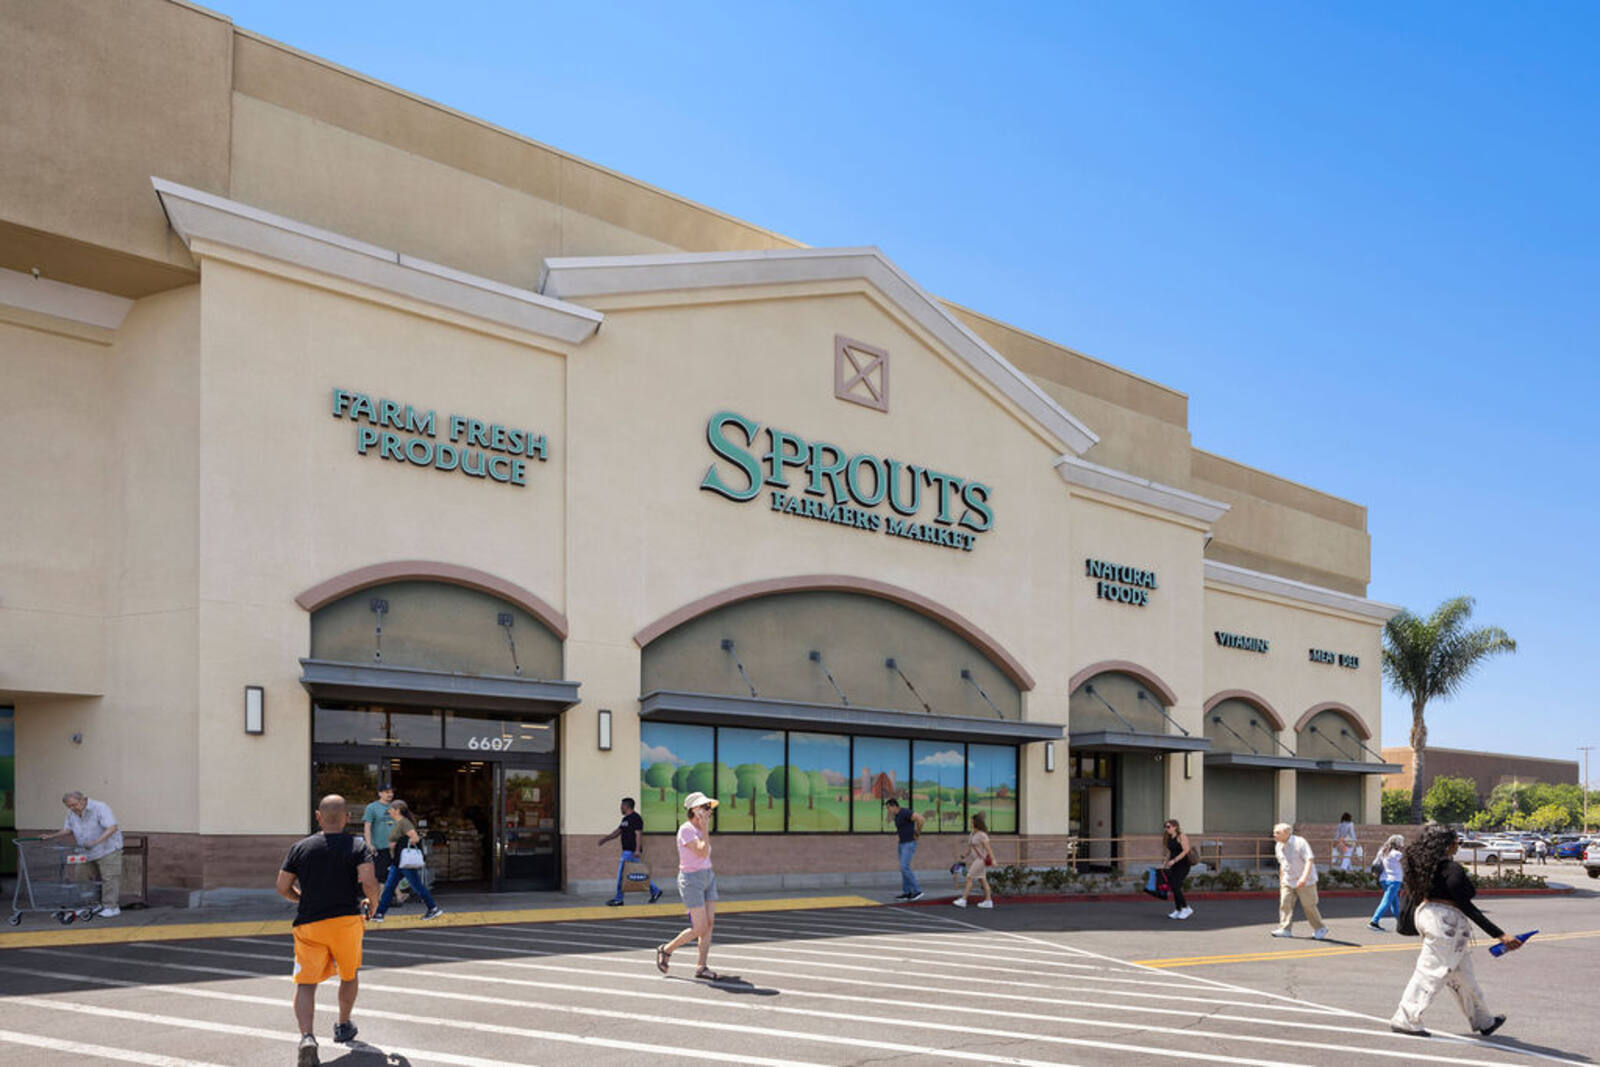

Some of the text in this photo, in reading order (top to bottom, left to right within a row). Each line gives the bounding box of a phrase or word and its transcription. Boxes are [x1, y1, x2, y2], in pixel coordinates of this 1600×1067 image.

[332, 387, 548, 461] FARM FRESH
[358, 425, 526, 486] PRODUCE
[700, 411, 994, 533] SPROUTS
[771, 491, 976, 552] FARMERS MARKET
[1085, 558, 1159, 589] NATURAL
[1097, 580, 1150, 606] FOODS
[1214, 631, 1269, 654] VITAMINS
[468, 737, 513, 751] 6607
